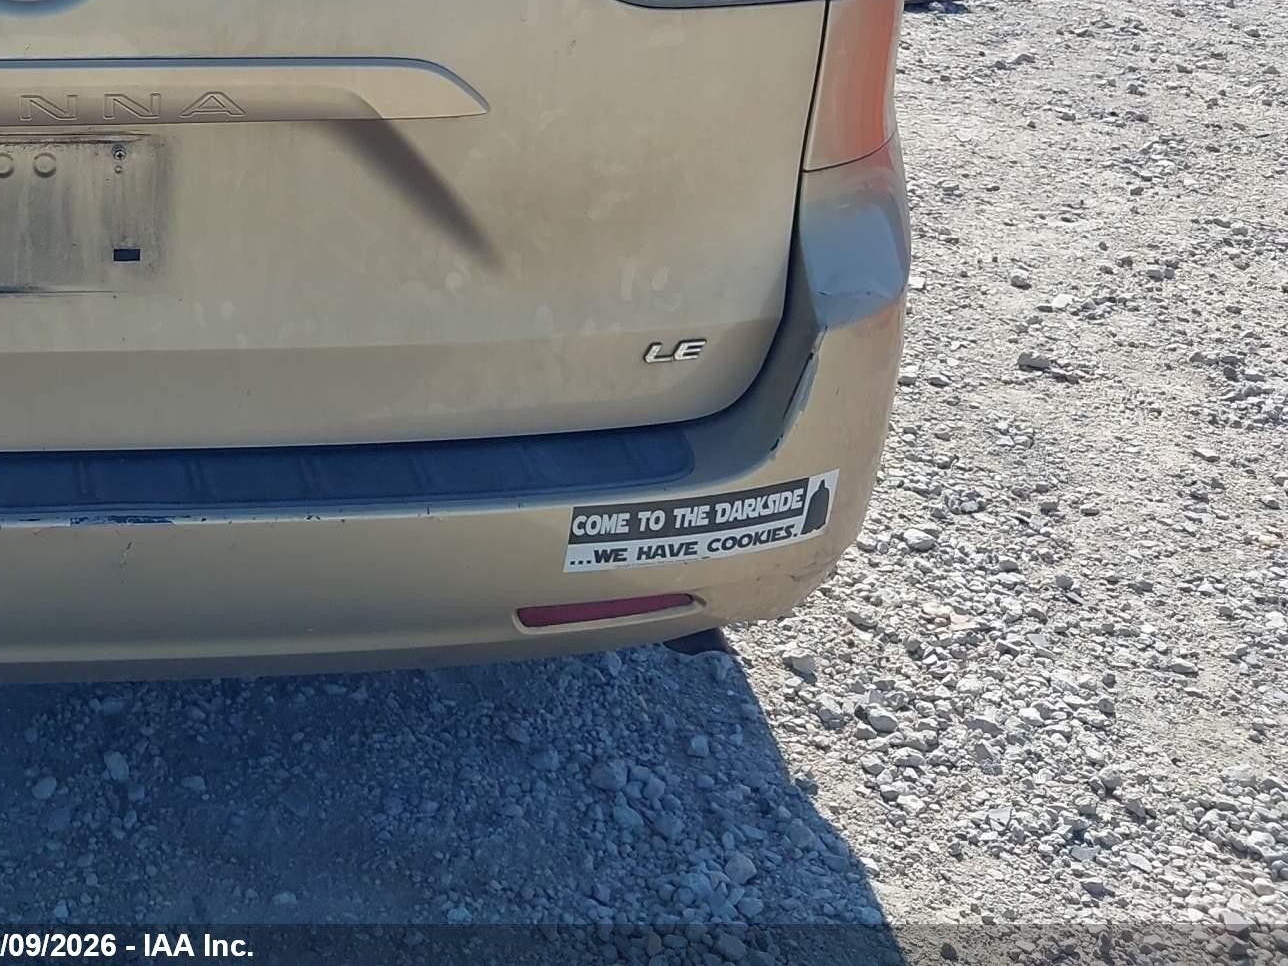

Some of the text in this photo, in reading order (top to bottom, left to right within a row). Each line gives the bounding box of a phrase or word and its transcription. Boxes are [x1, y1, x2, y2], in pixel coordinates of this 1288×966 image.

[643, 338, 707, 363] LE
[572, 488, 804, 535] COME TO THE DARKSIDE
[570, 524, 798, 565] ...WE HAVE COOKIES.
